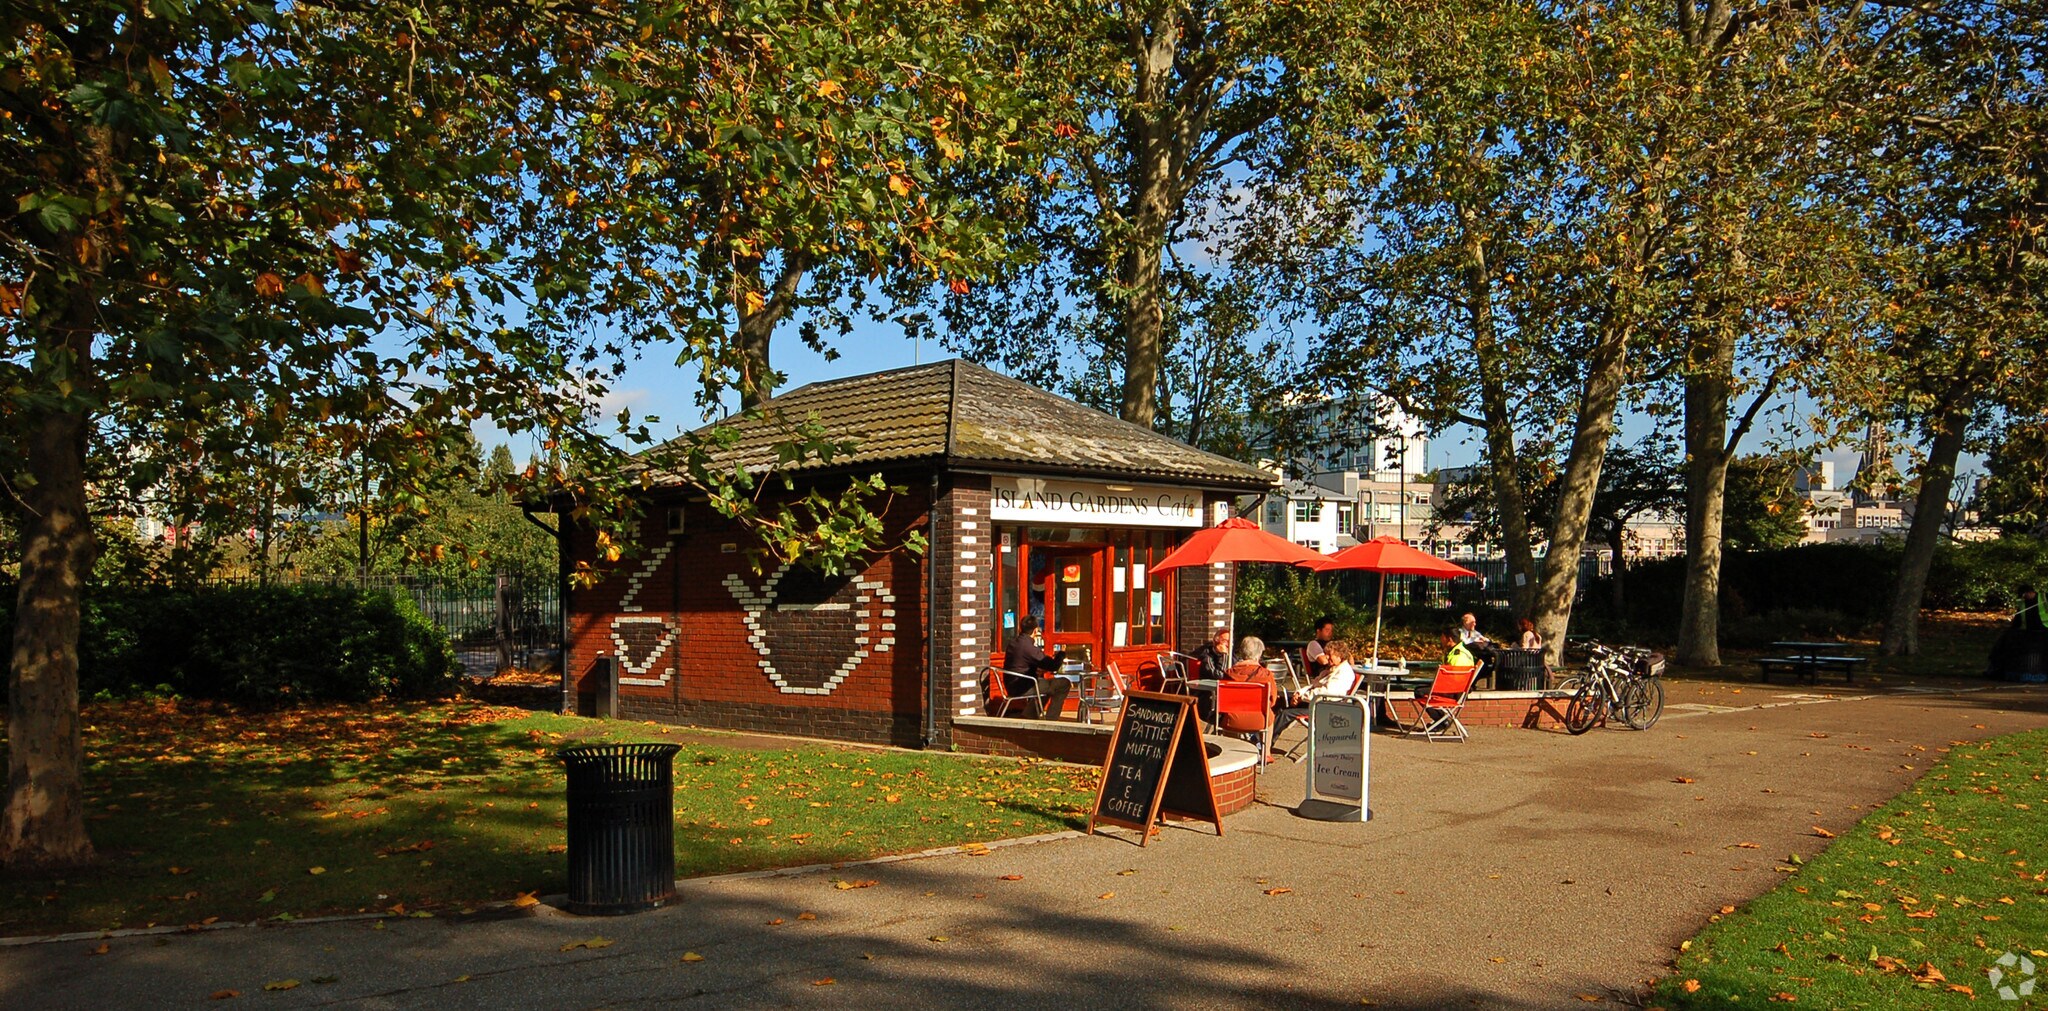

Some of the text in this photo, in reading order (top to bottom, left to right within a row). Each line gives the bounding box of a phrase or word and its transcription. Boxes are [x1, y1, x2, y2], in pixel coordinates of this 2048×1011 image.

[994, 487, 1195, 522] ISLAND GARDENS Café
[1118, 764, 1142, 781] TEA
[1317, 763, 1360, 779] Ice Cream
[1108, 797, 1144, 818] COFFEE
